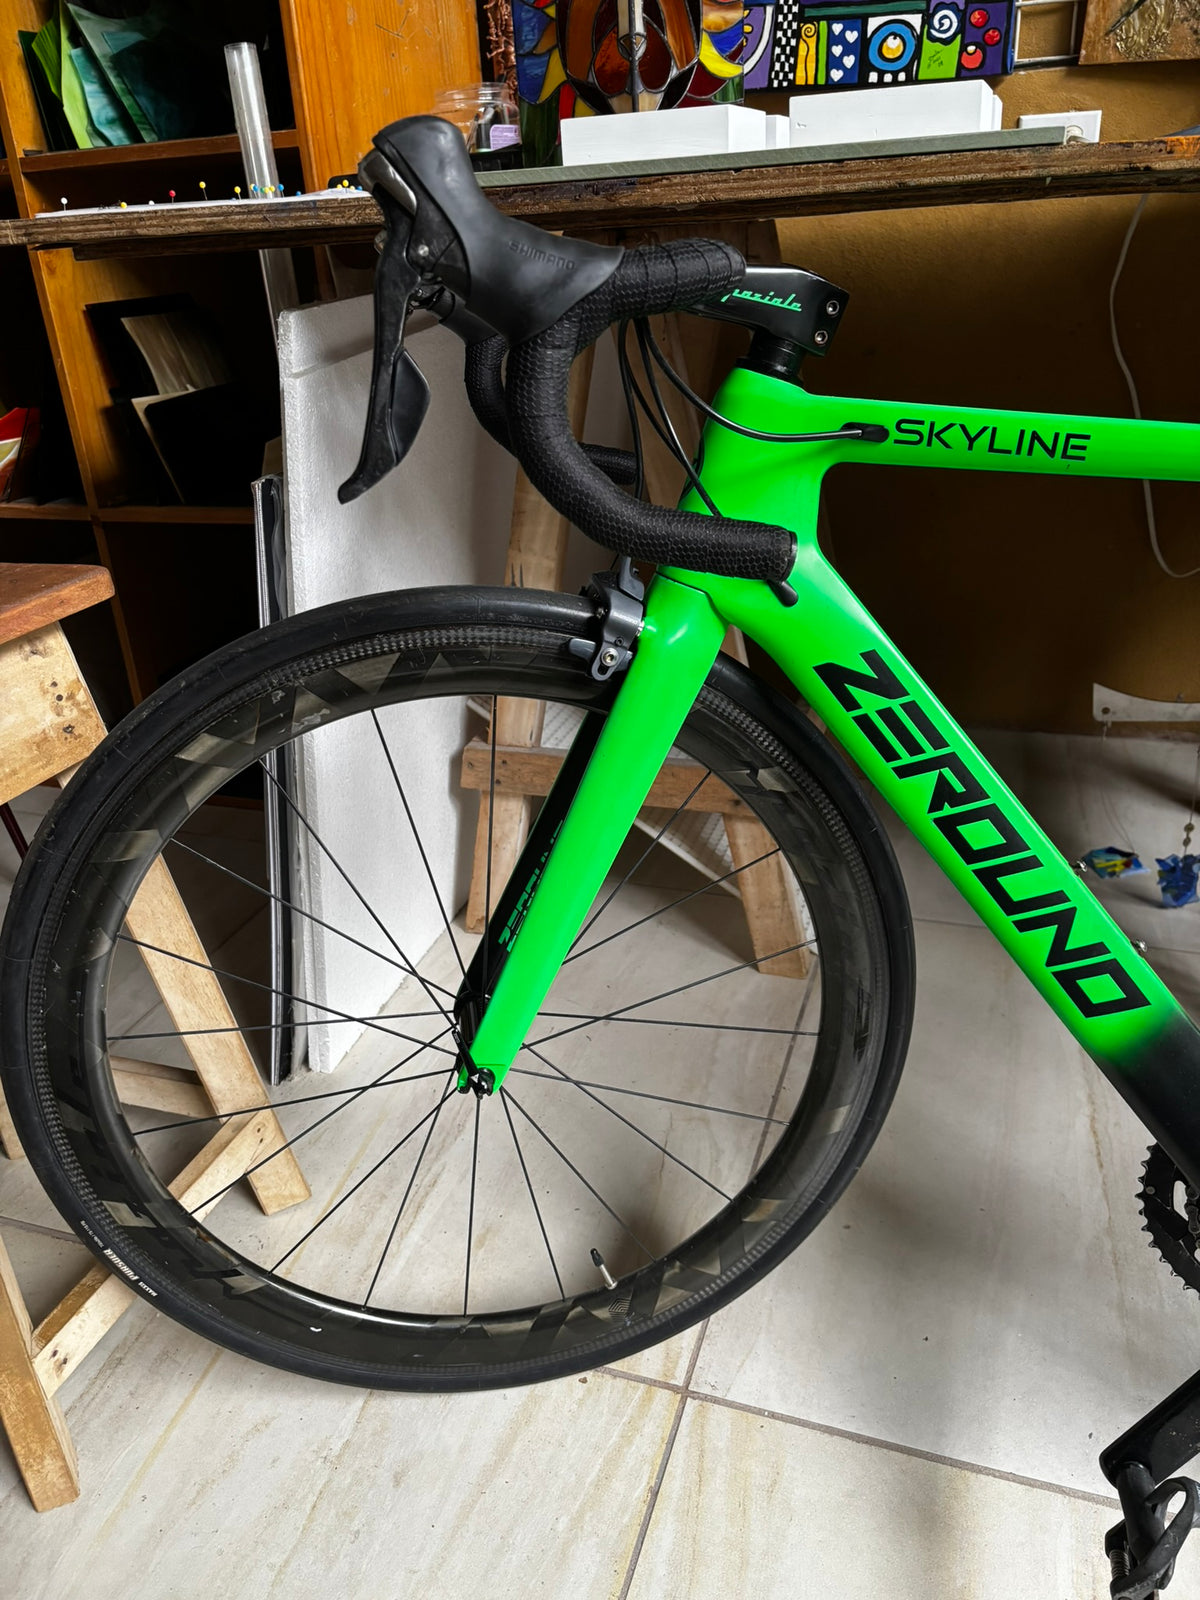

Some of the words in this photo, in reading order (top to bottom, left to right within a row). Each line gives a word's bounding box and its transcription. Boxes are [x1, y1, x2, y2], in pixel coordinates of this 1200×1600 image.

[507, 240, 576, 271] SHIMANO
[893, 418, 1091, 461] SKYLINE
[812, 649, 1152, 1019] ZEROUND
[103, 1248, 139, 1280] PURSUER
